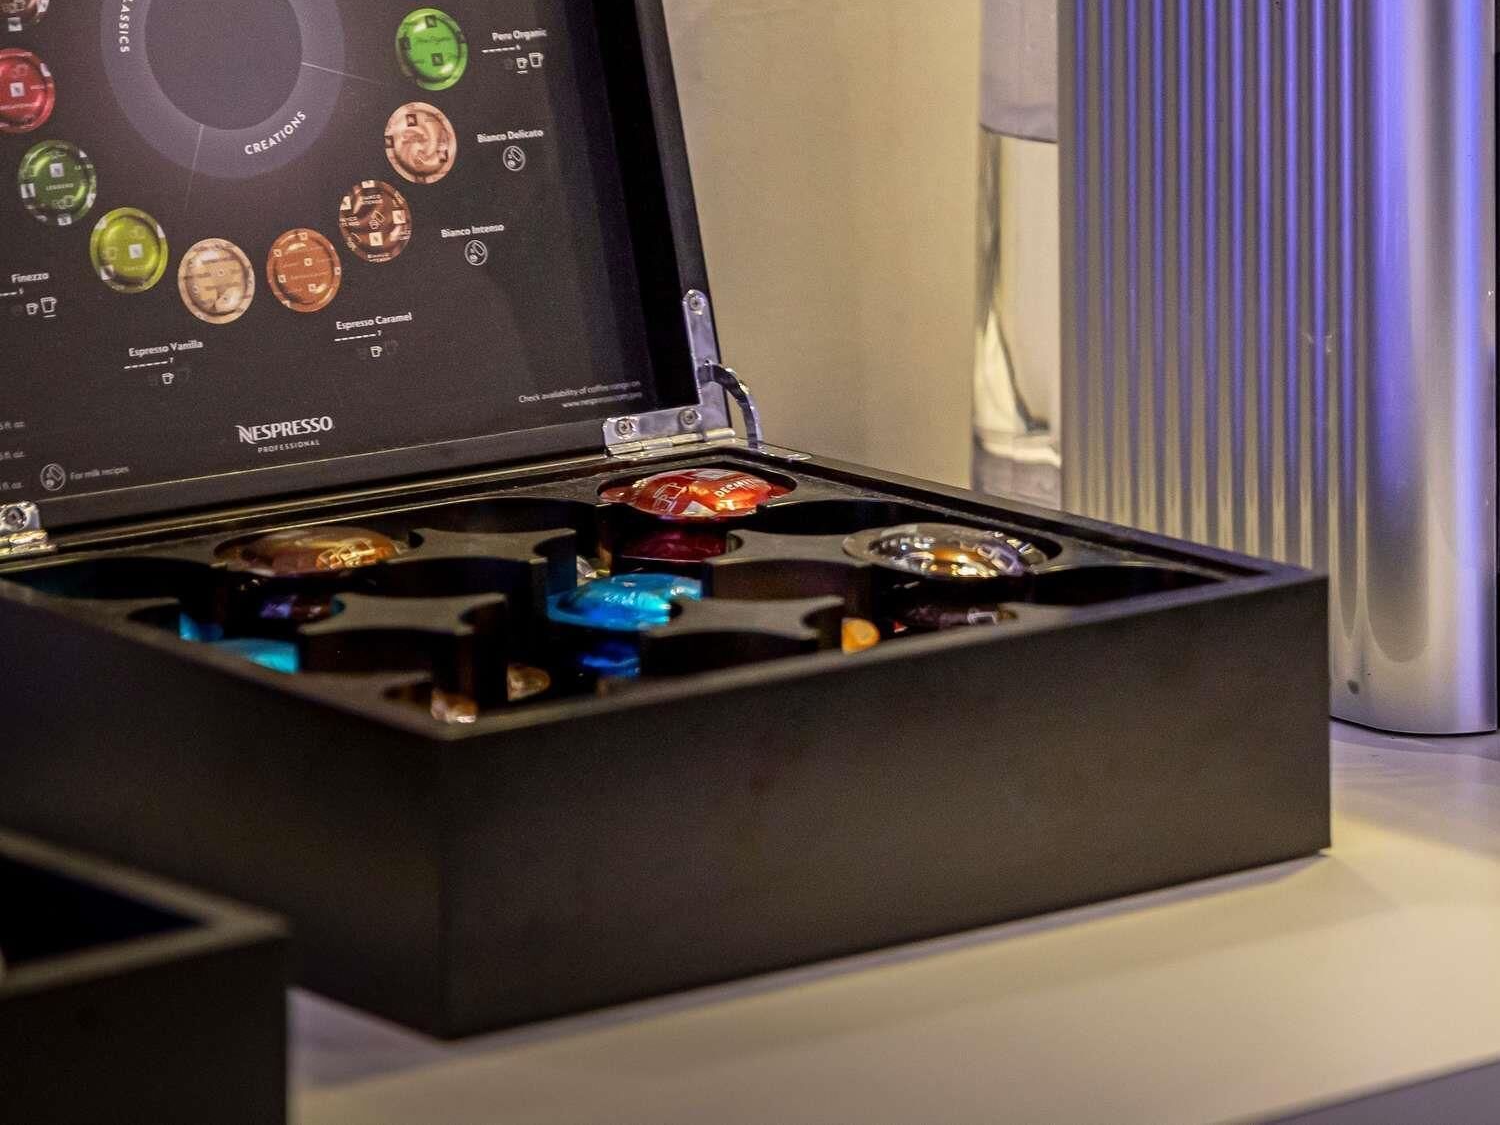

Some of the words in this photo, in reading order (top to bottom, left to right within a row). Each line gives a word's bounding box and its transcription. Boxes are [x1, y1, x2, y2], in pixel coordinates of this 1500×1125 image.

[491, 31, 513, 42] Peru
[512, 28, 547, 41] Organic
[243, 110, 307, 156] CREATIONS
[477, 132, 506, 143] Bianco
[507, 129, 544, 140] Delicato
[440, 226, 471, 238] Bianco
[471, 222, 505, 235] Intenso
[11, 272, 50, 284] Finezzo
[336, 318, 375, 333] Espresso
[375, 312, 413, 326] Caramel
[128, 344, 168, 359] Espresso
[169, 338, 204, 352] Vanilla
[234, 415, 334, 445] NESPRESSO
[257, 438, 321, 454] PROFESSIONAL
[70, 470, 84, 481] For
[84, 467, 100, 479] milk
[100, 465, 130, 478] recipes
